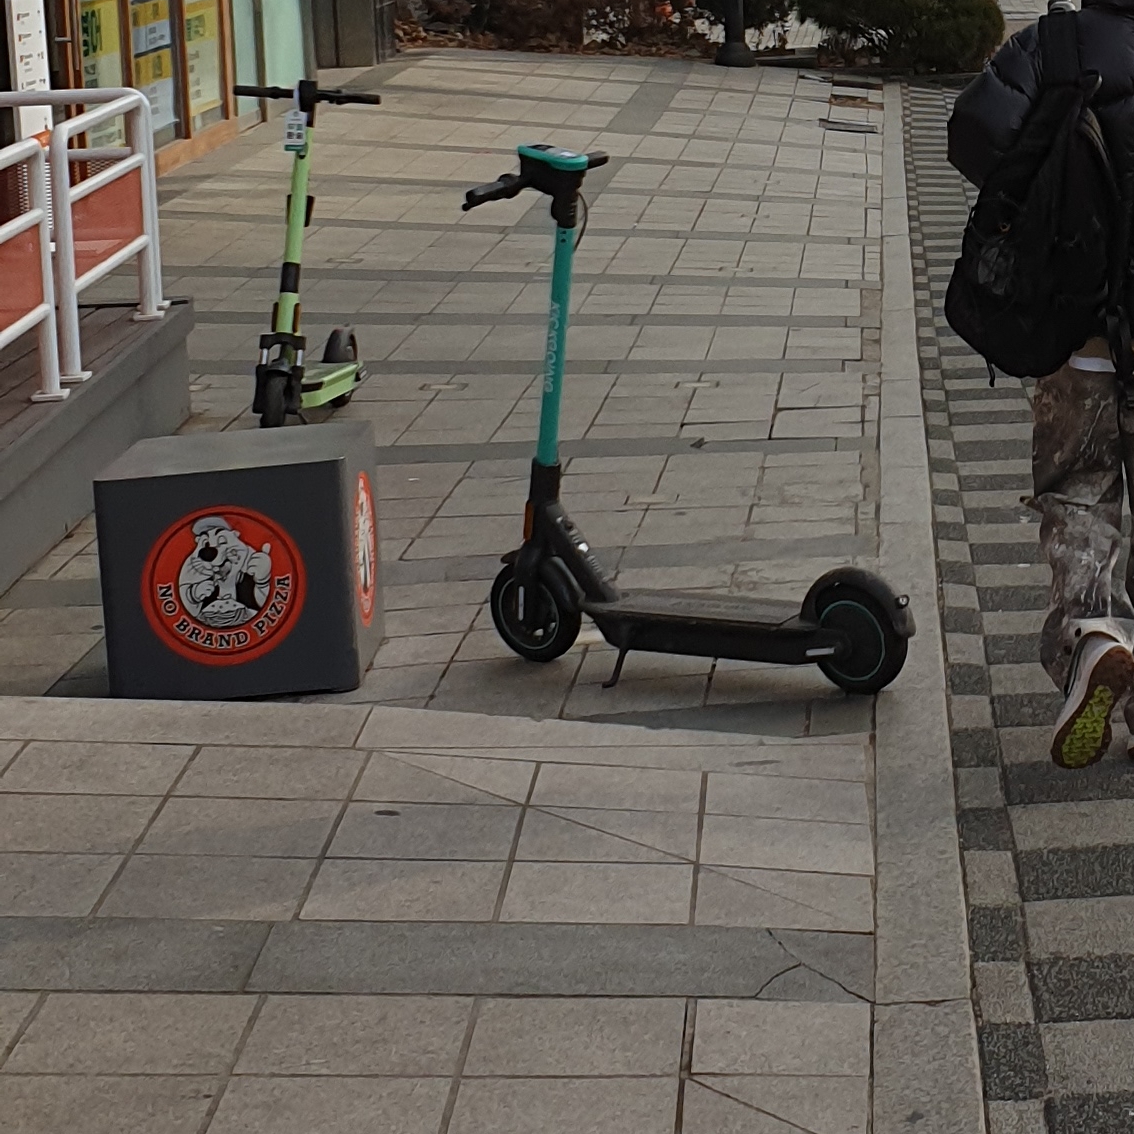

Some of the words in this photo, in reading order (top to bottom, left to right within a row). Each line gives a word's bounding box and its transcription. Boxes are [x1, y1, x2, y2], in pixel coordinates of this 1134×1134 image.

[157, 582, 180, 617] NO
[174, 615, 250, 649] BRAND
[252, 573, 292, 638] PIZZA
